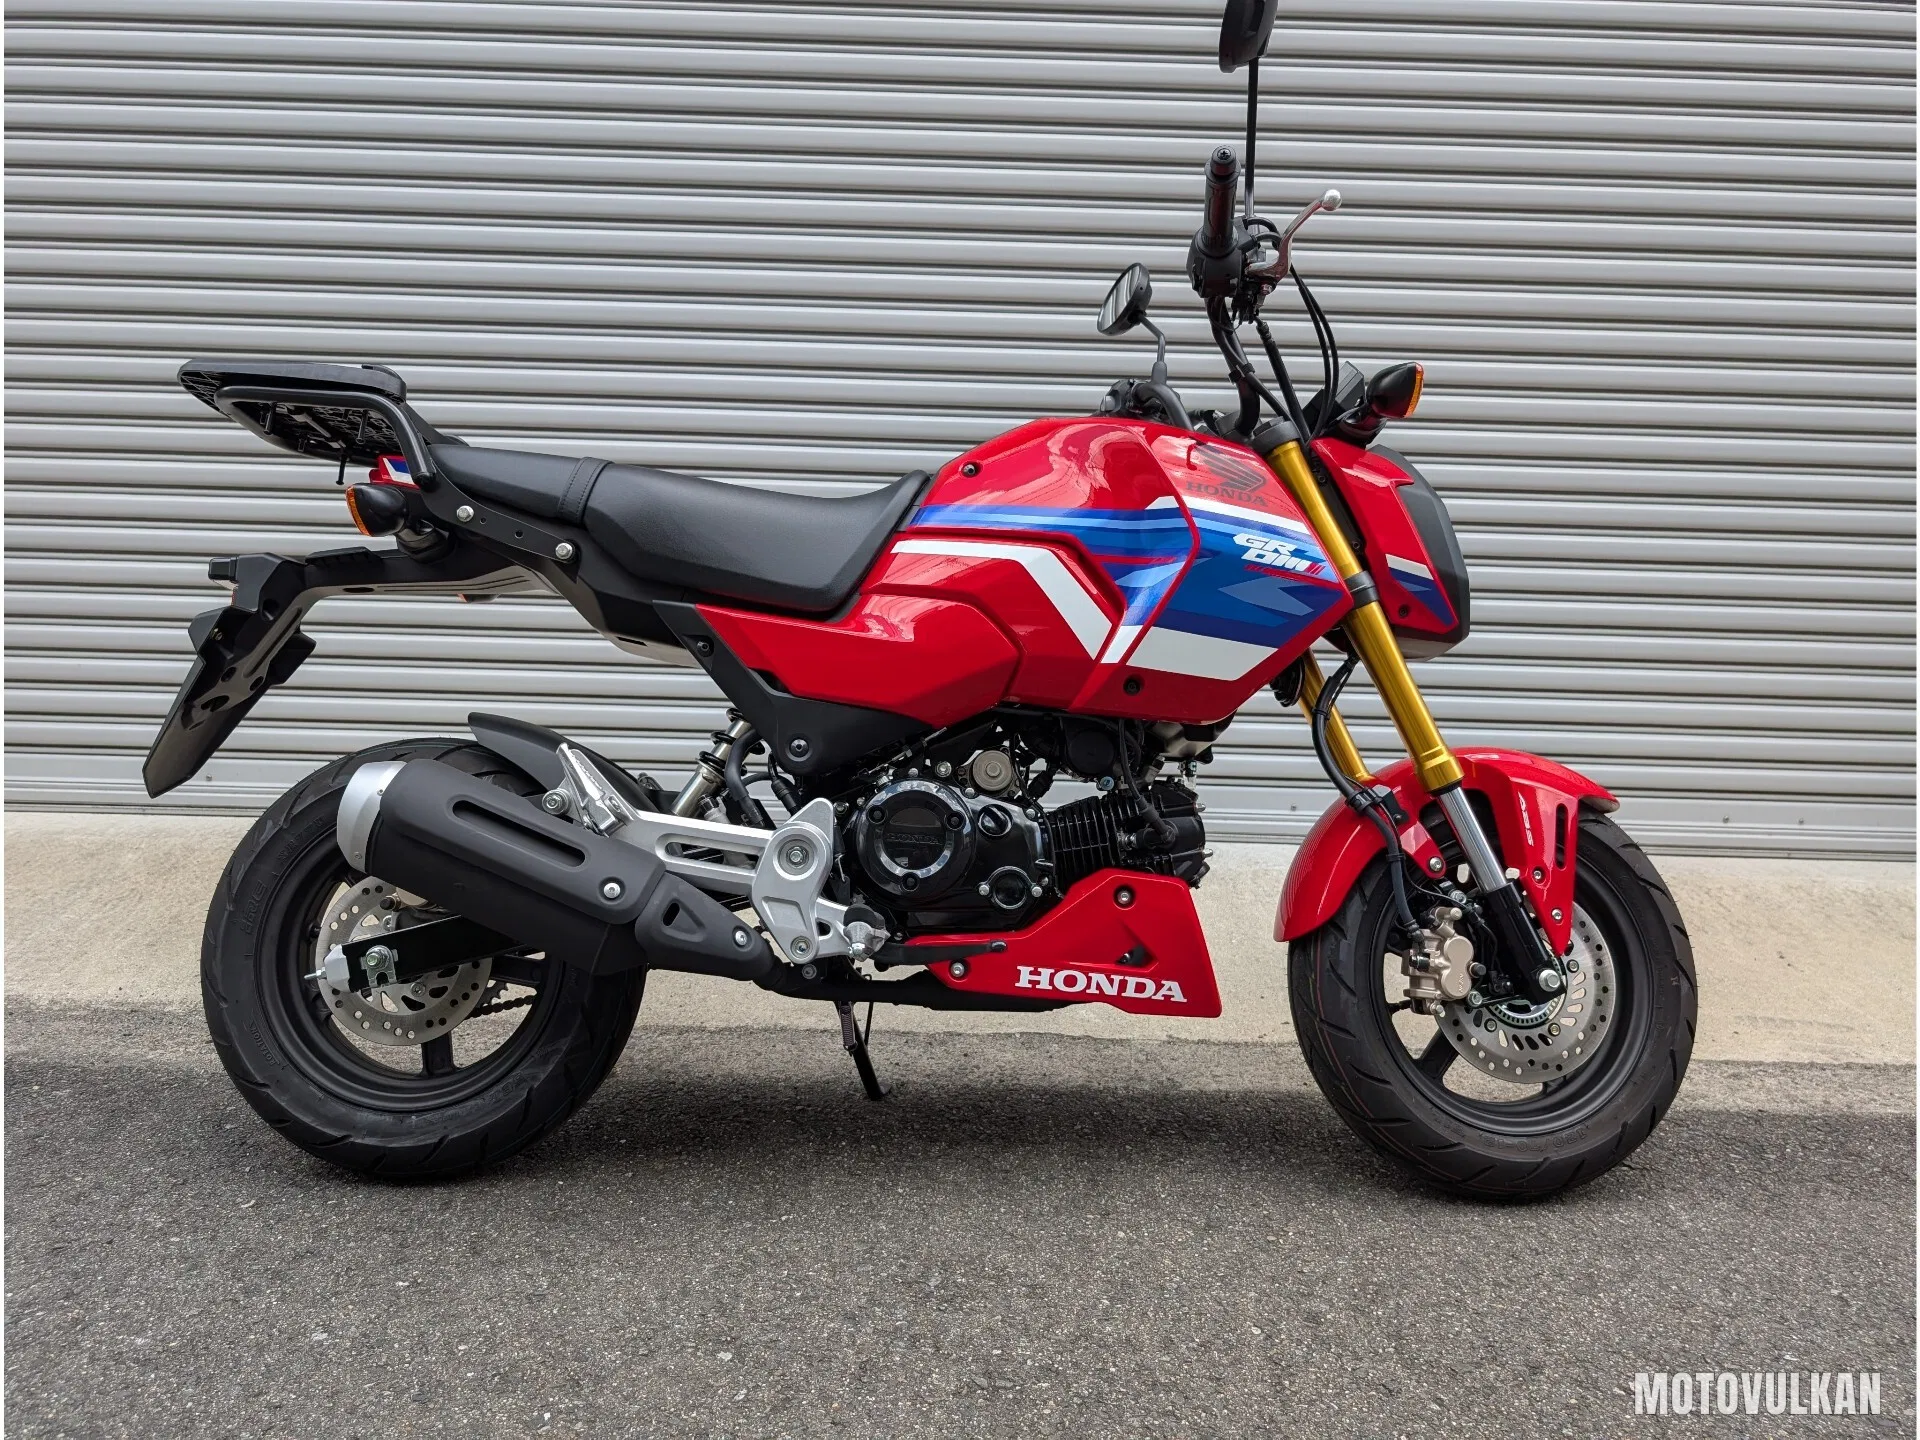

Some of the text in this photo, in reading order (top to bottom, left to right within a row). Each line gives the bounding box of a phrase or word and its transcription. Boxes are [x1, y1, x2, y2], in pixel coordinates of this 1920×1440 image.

[1186, 481, 1268, 507] HONDA
[887, 832, 940, 845] HONDA
[1015, 966, 1187, 1002] HONDA
